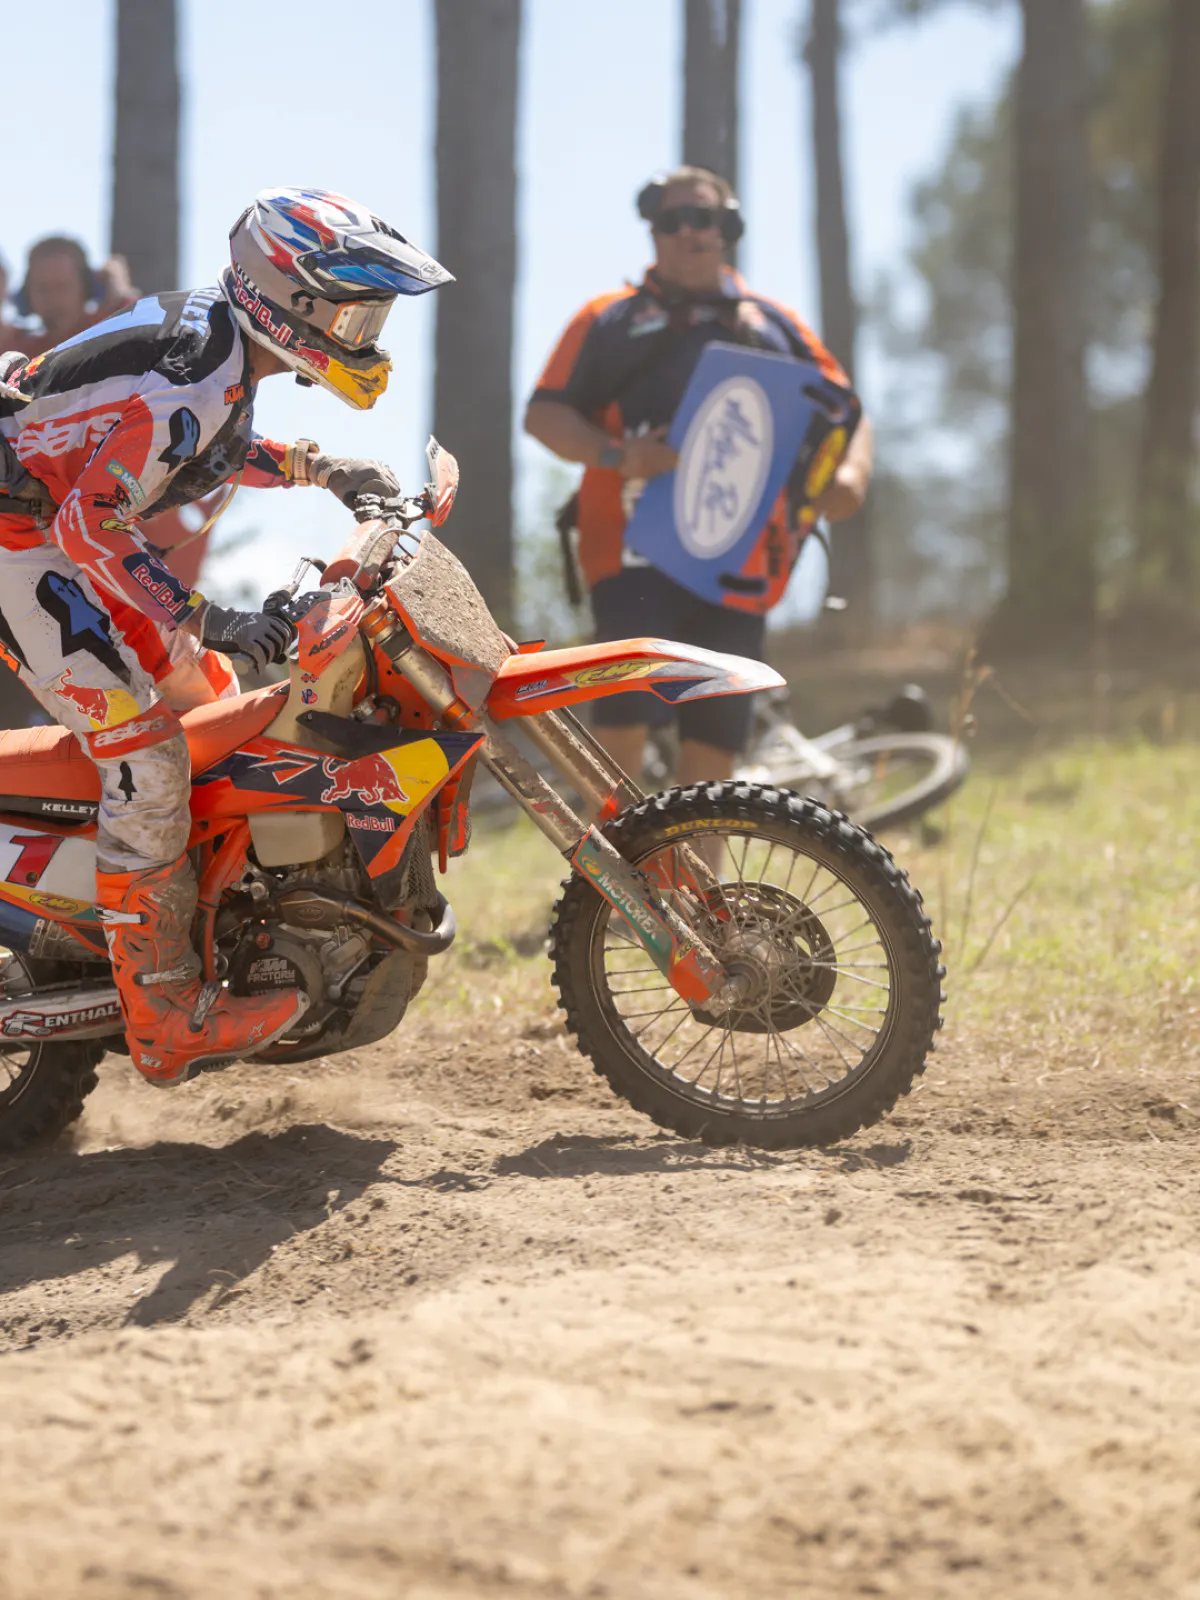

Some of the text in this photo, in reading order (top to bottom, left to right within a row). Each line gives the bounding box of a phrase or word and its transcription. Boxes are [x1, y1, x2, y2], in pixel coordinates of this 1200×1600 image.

[233, 276, 261, 316] Red
[256, 304, 294, 346] Bull
[224, 383, 245, 405] KTM
[12, 412, 123, 461] stars
[132, 564, 167, 598] Red
[42, 802, 97, 815] KELLEY
[346, 812, 395, 832] Red Bull
[664, 819, 758, 836] DUNLOP
[4, 834, 65, 888] 1
[249, 957, 288, 974] KTM
[247, 969, 296, 984] FACTORY
